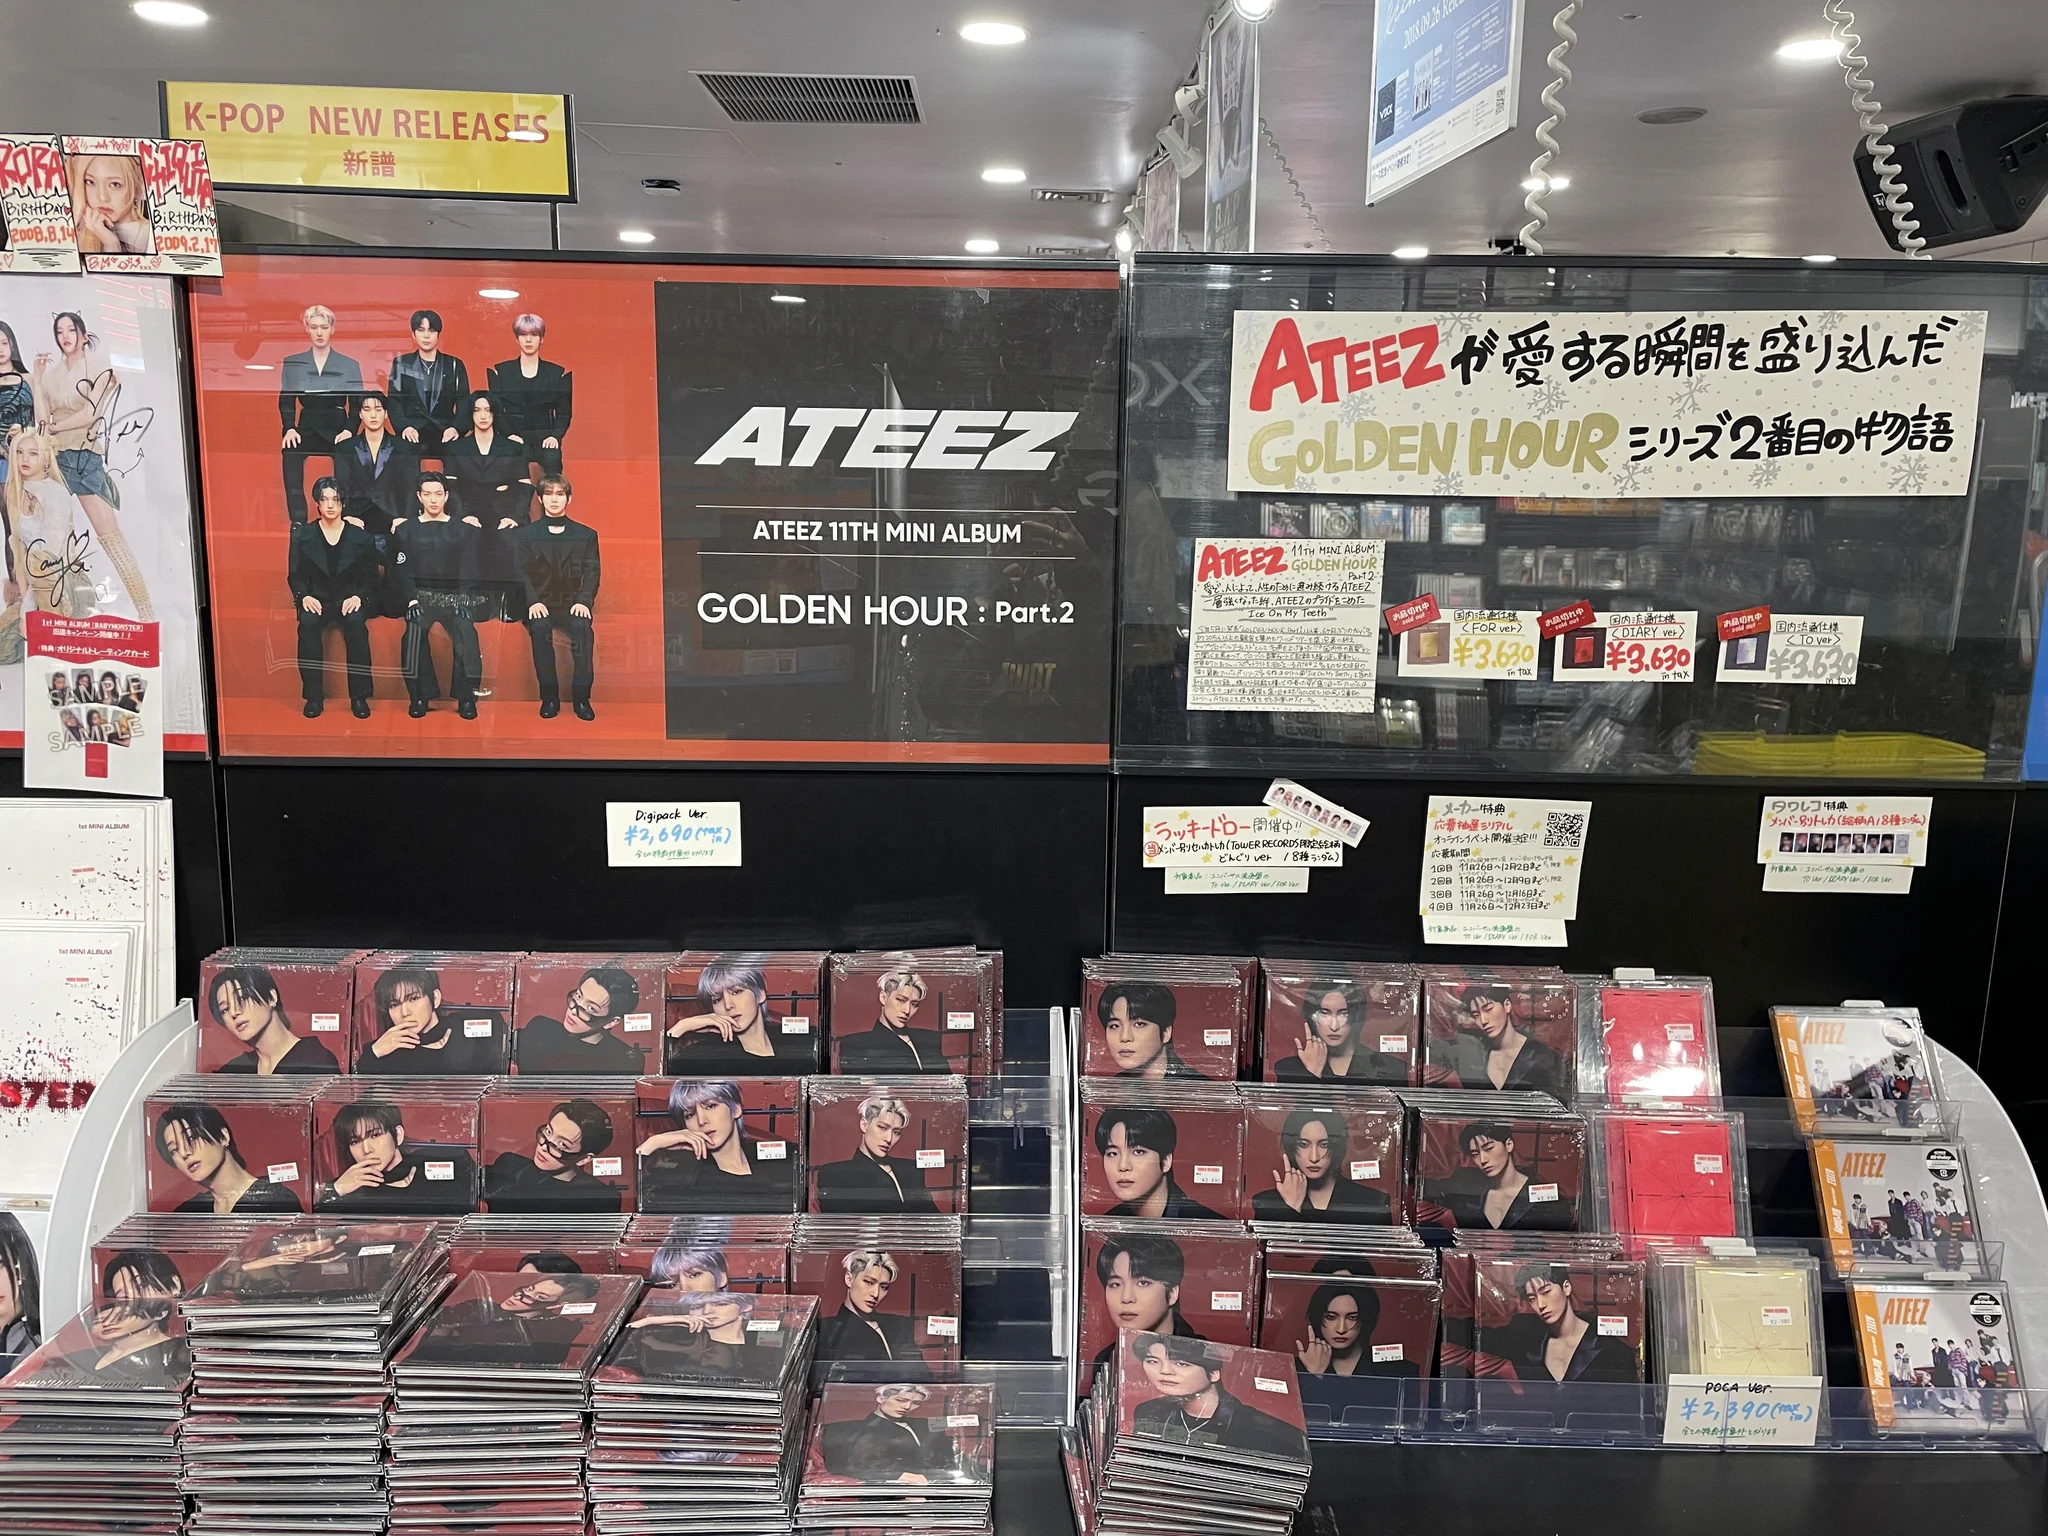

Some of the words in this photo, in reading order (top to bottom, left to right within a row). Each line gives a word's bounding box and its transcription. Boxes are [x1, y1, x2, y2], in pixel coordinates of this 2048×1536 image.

[184, 101, 285, 134] K-POP
[309, 105, 384, 137] NEW
[394, 109, 549, 144] RELEASES
[343, 150, 396, 177] 新譜
[11, 226, 75, 244] 2008.8.14
[156, 236, 218, 253] 2009.2.17
[694, 406, 1080, 471] ATEEZ
[1468, 411, 1621, 478] HOUR
[1627, 402, 1954, 464] シリーズ2番目の物語
[752, 520, 823, 541] ATEEZ
[829, 522, 879, 542] 11TH
[885, 522, 936, 543] MINI
[941, 523, 1022, 544] ALBUM
[1197, 544, 1289, 582] ATEEZ
[1292, 544, 1315, 556] 11TH
[1319, 545, 1342, 555] MINI
[1344, 544, 1375, 555] ALBUM
[1342, 557, 1377, 570] HOUR
[1348, 571, 1366, 582] Part
[697, 592, 851, 626] GOLDEN
[864, 595, 969, 627] HOUR
[995, 600, 1075, 625] Part.2
[1268, 609, 1282, 618] On
[1285, 610, 1298, 619] My
[1302, 608, 1327, 618] Teeth
[1392, 602, 1430, 621] お品切れ中
[1545, 607, 1585, 628] お品切れ中
[69, 620, 90, 628] ALBUM
[1723, 613, 1763, 628] お品切れ中
[1517, 668, 1532, 676] tax
[1672, 671, 1690, 680] tax
[48, 673, 144, 709] SAMPLE
[48, 717, 144, 752] SAMPLE
[635, 808, 681, 824] Digipack
[1803, 1022, 1846, 1044] ATEEZ
[1841, 1152, 1887, 1178] ATEEZ
[1883, 1298, 1930, 1325] ATEEZ
[1705, 1383, 1739, 1394] POCA
